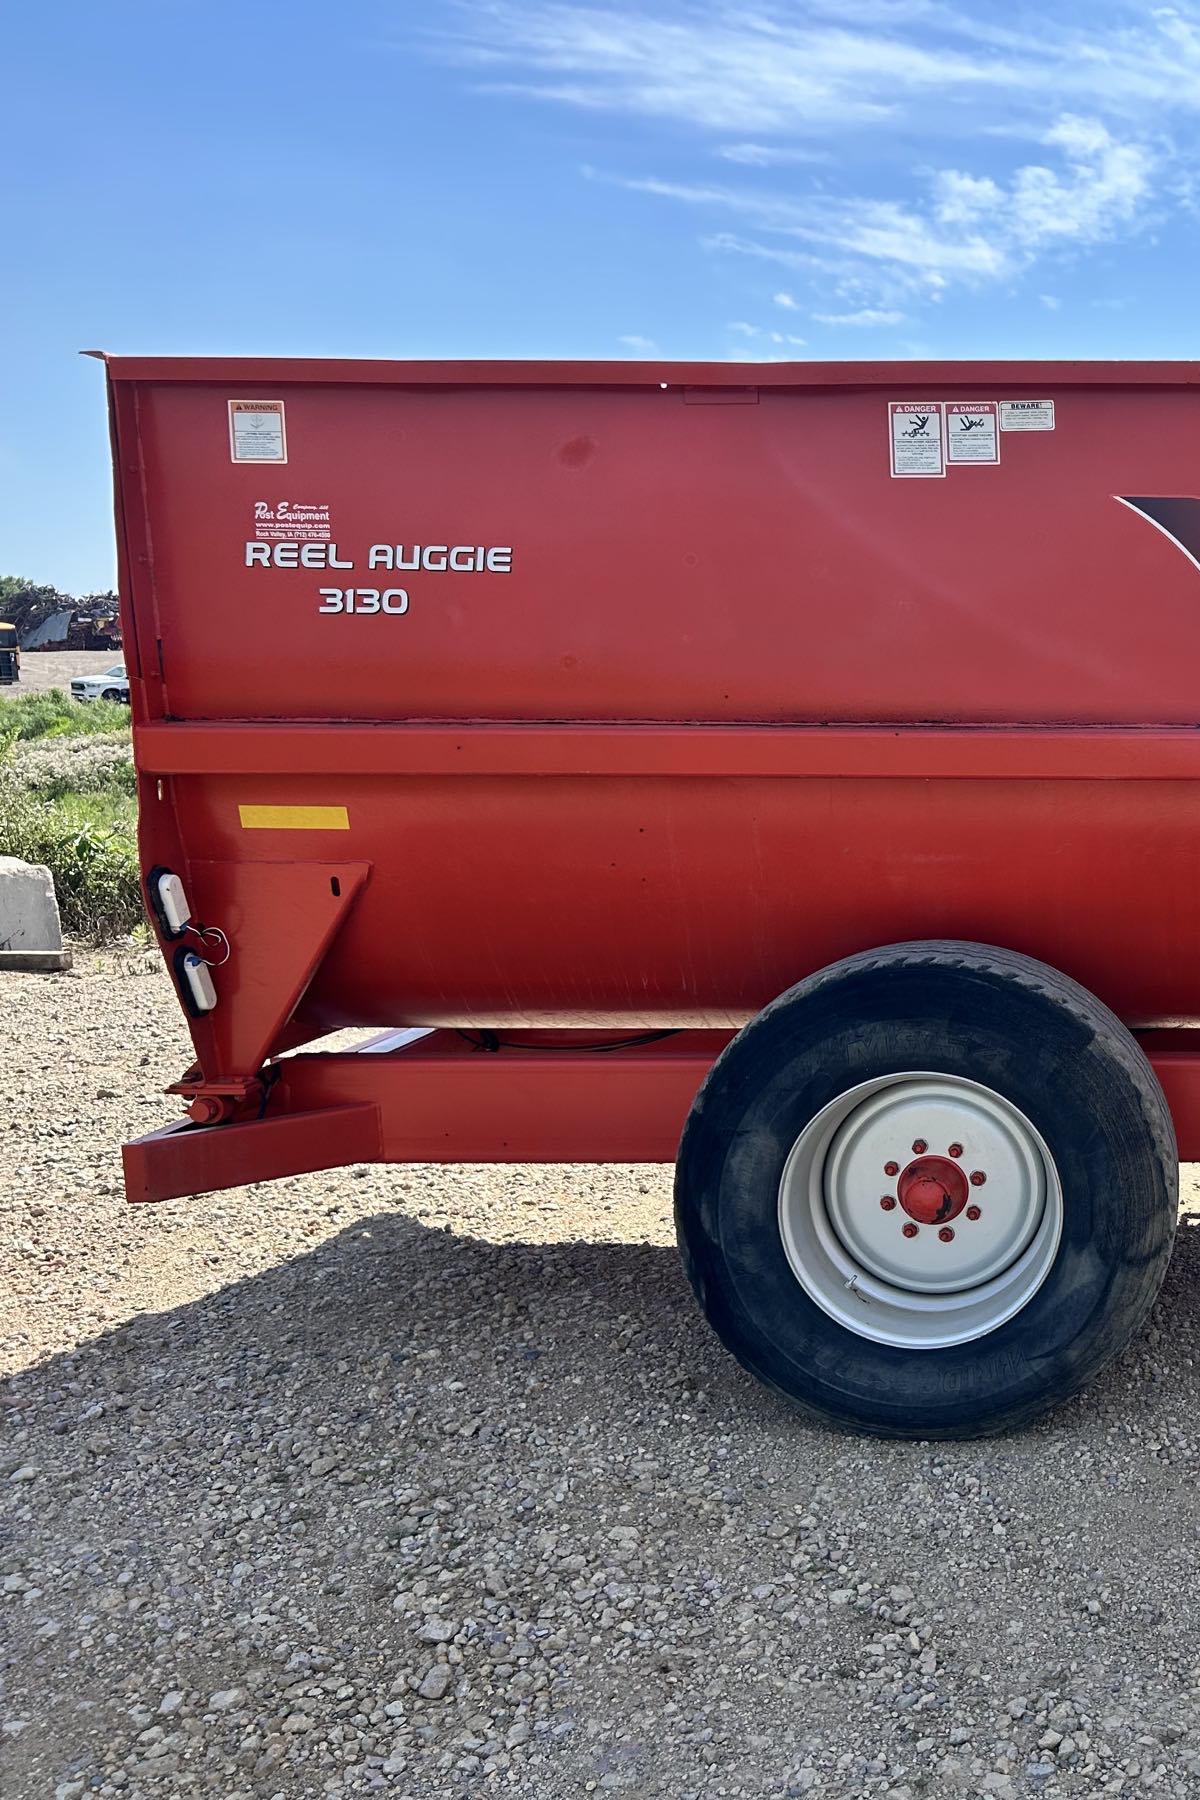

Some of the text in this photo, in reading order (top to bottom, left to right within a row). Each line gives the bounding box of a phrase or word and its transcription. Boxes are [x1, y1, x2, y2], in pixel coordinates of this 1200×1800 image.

[254, 501, 330, 522] Post Equipment
[245, 542, 512, 573] REEL AUGGIE
[319, 588, 408, 614] 3130
